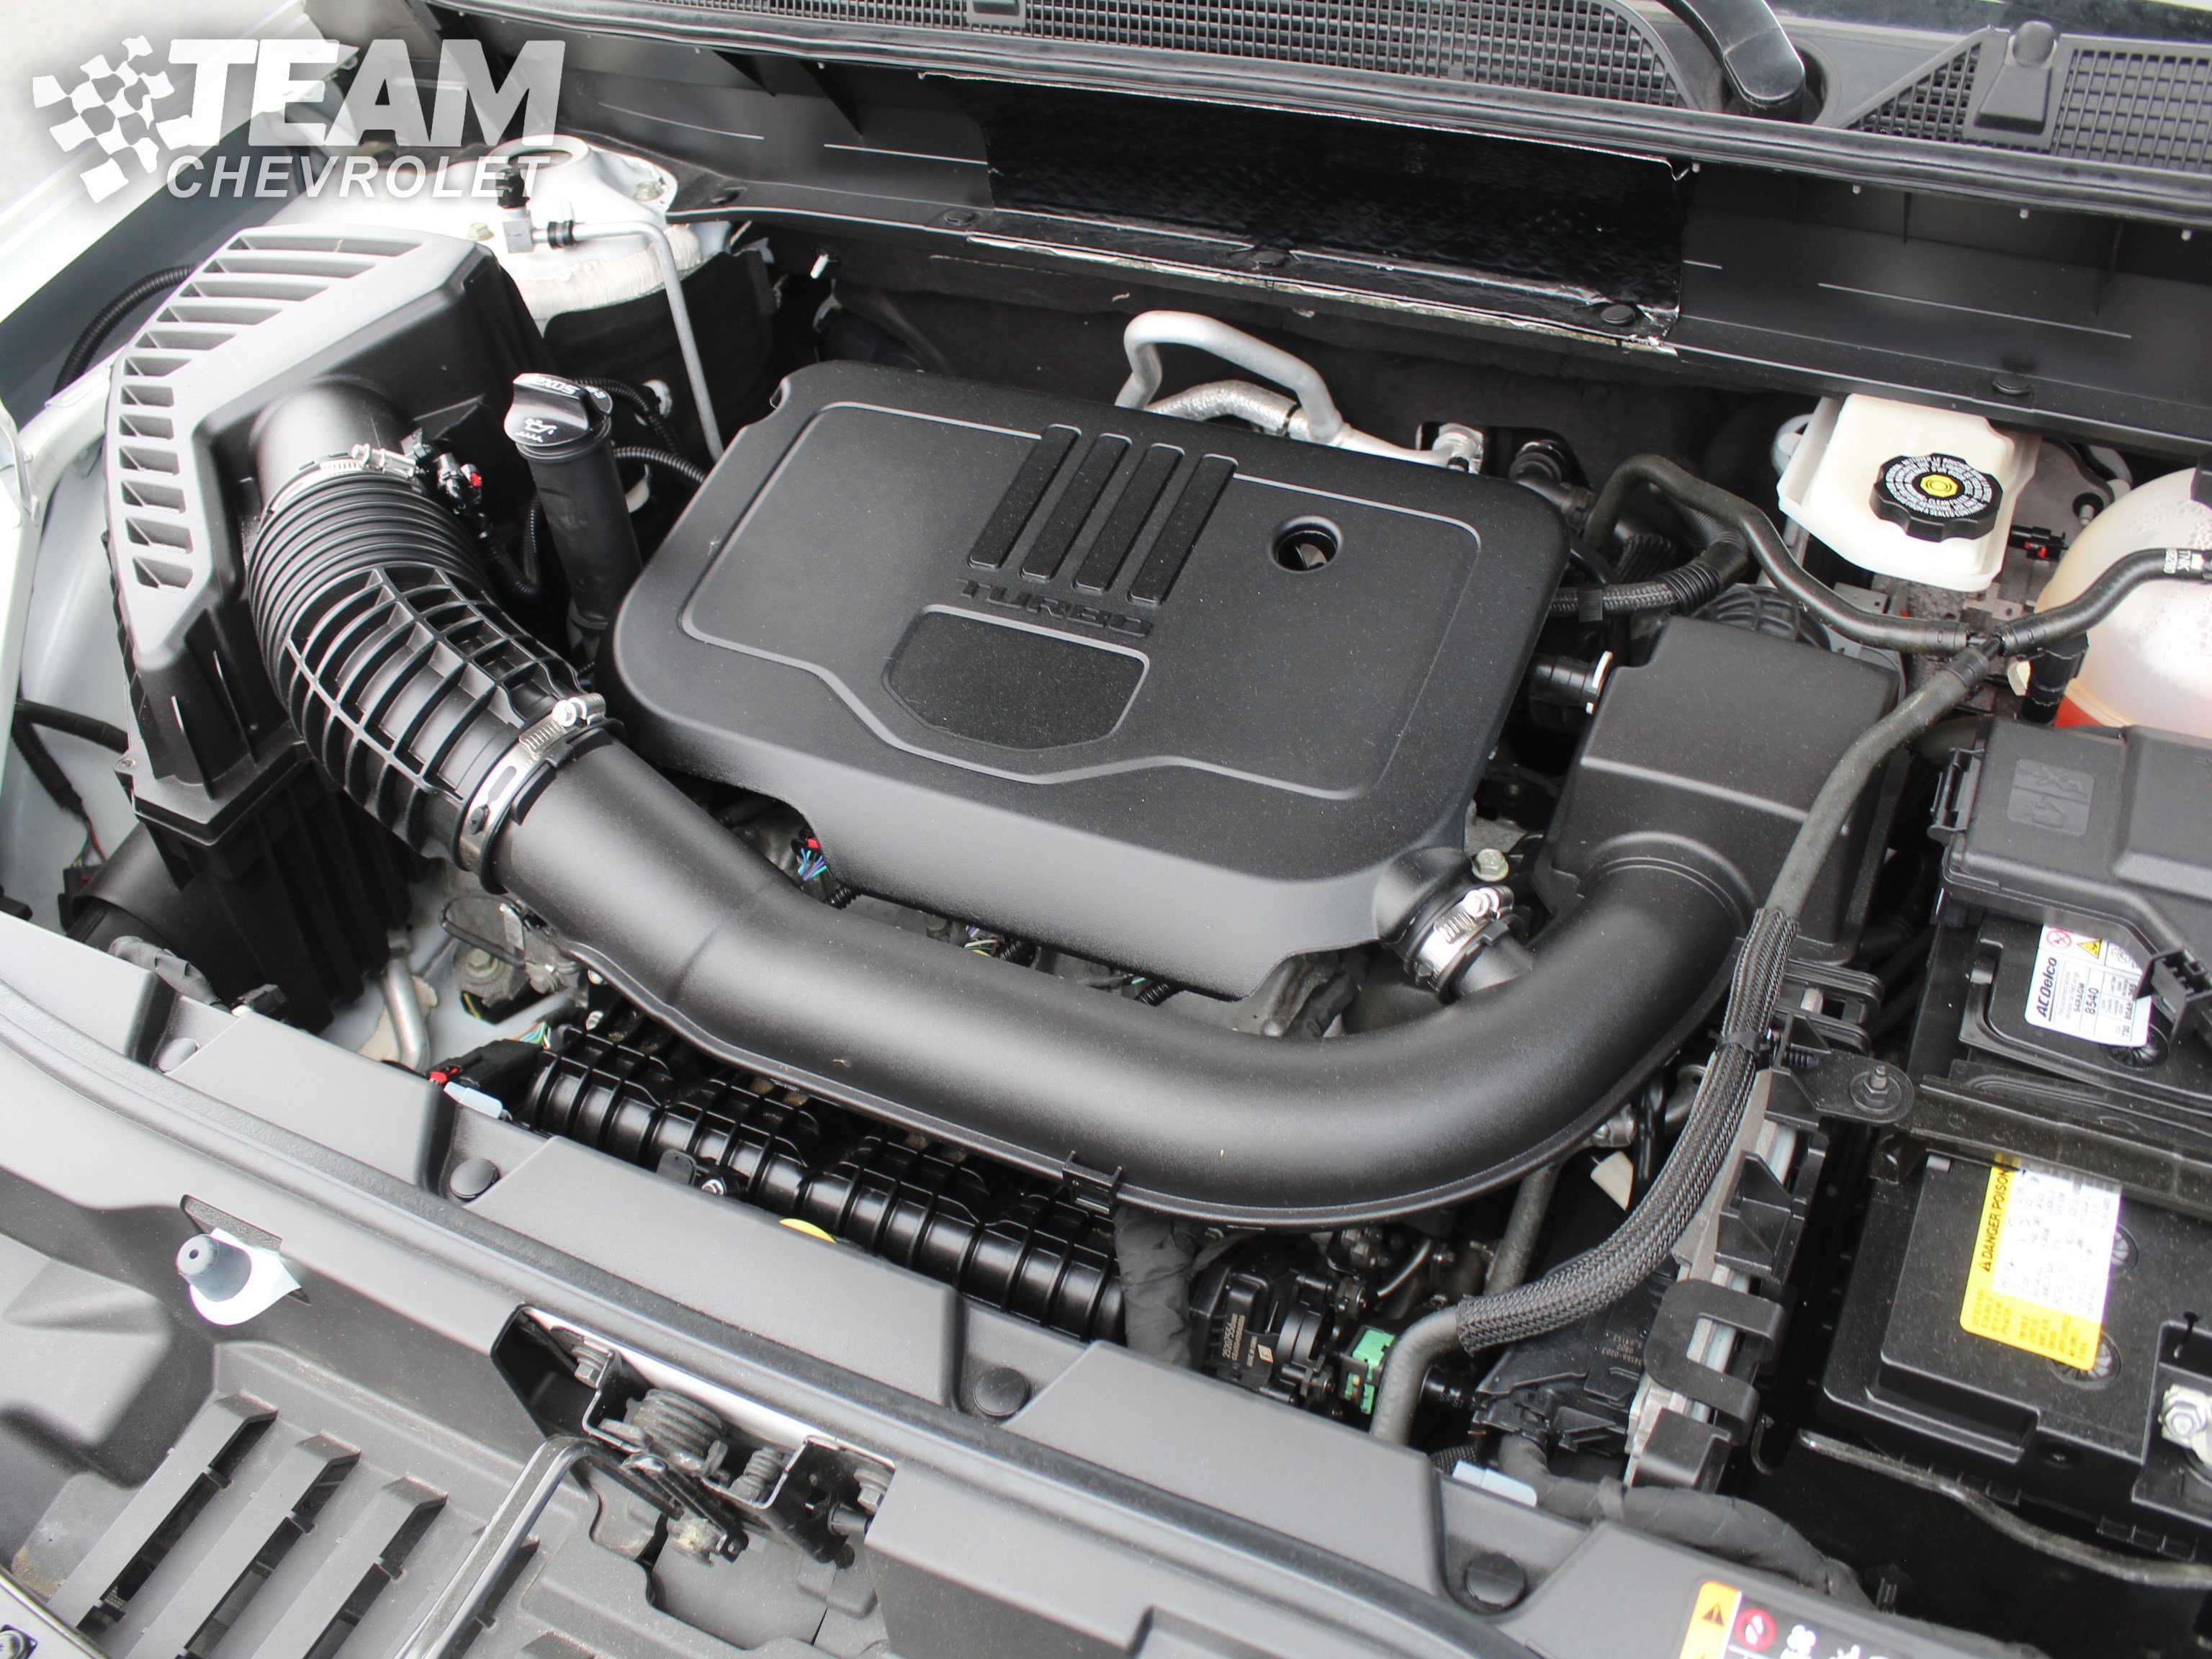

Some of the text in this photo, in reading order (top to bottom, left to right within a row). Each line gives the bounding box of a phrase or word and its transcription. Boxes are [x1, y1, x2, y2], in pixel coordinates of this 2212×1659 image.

[1929, 509, 1955, 518] SEALED
[955, 577, 1154, 639] TURBO
[2036, 957, 2057, 1018] ACDelco
[2085, 987, 2099, 1015] 8540
